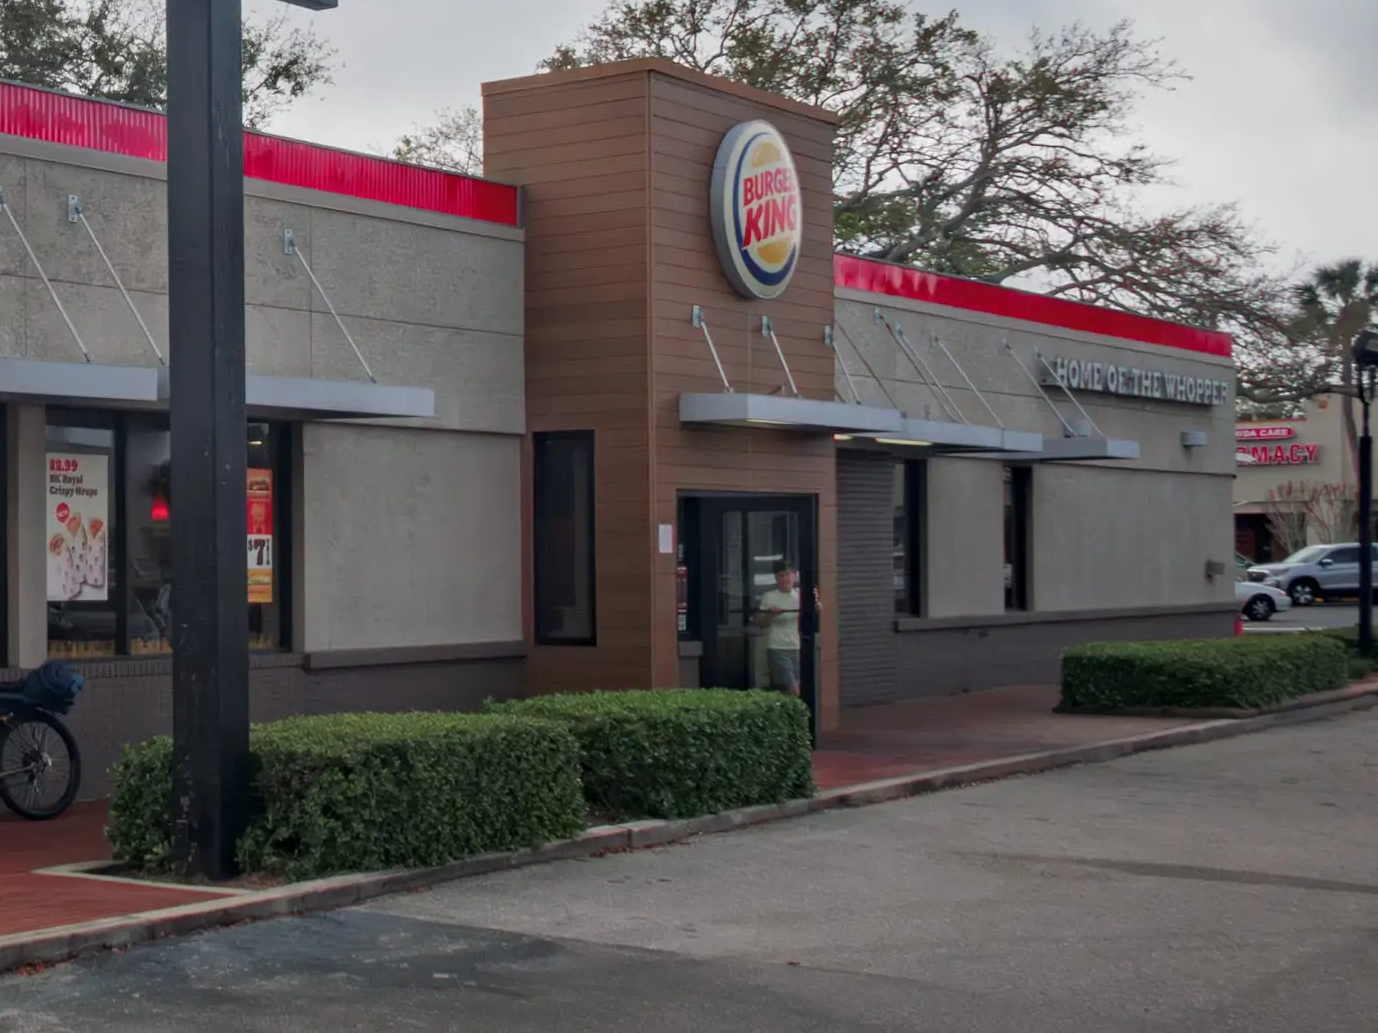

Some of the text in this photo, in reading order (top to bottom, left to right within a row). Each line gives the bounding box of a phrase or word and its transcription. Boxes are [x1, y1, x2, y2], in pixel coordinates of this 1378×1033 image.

[743, 194, 797, 246] KING
[1056, 357, 1228, 405] HOME OF THE WHOPPER
